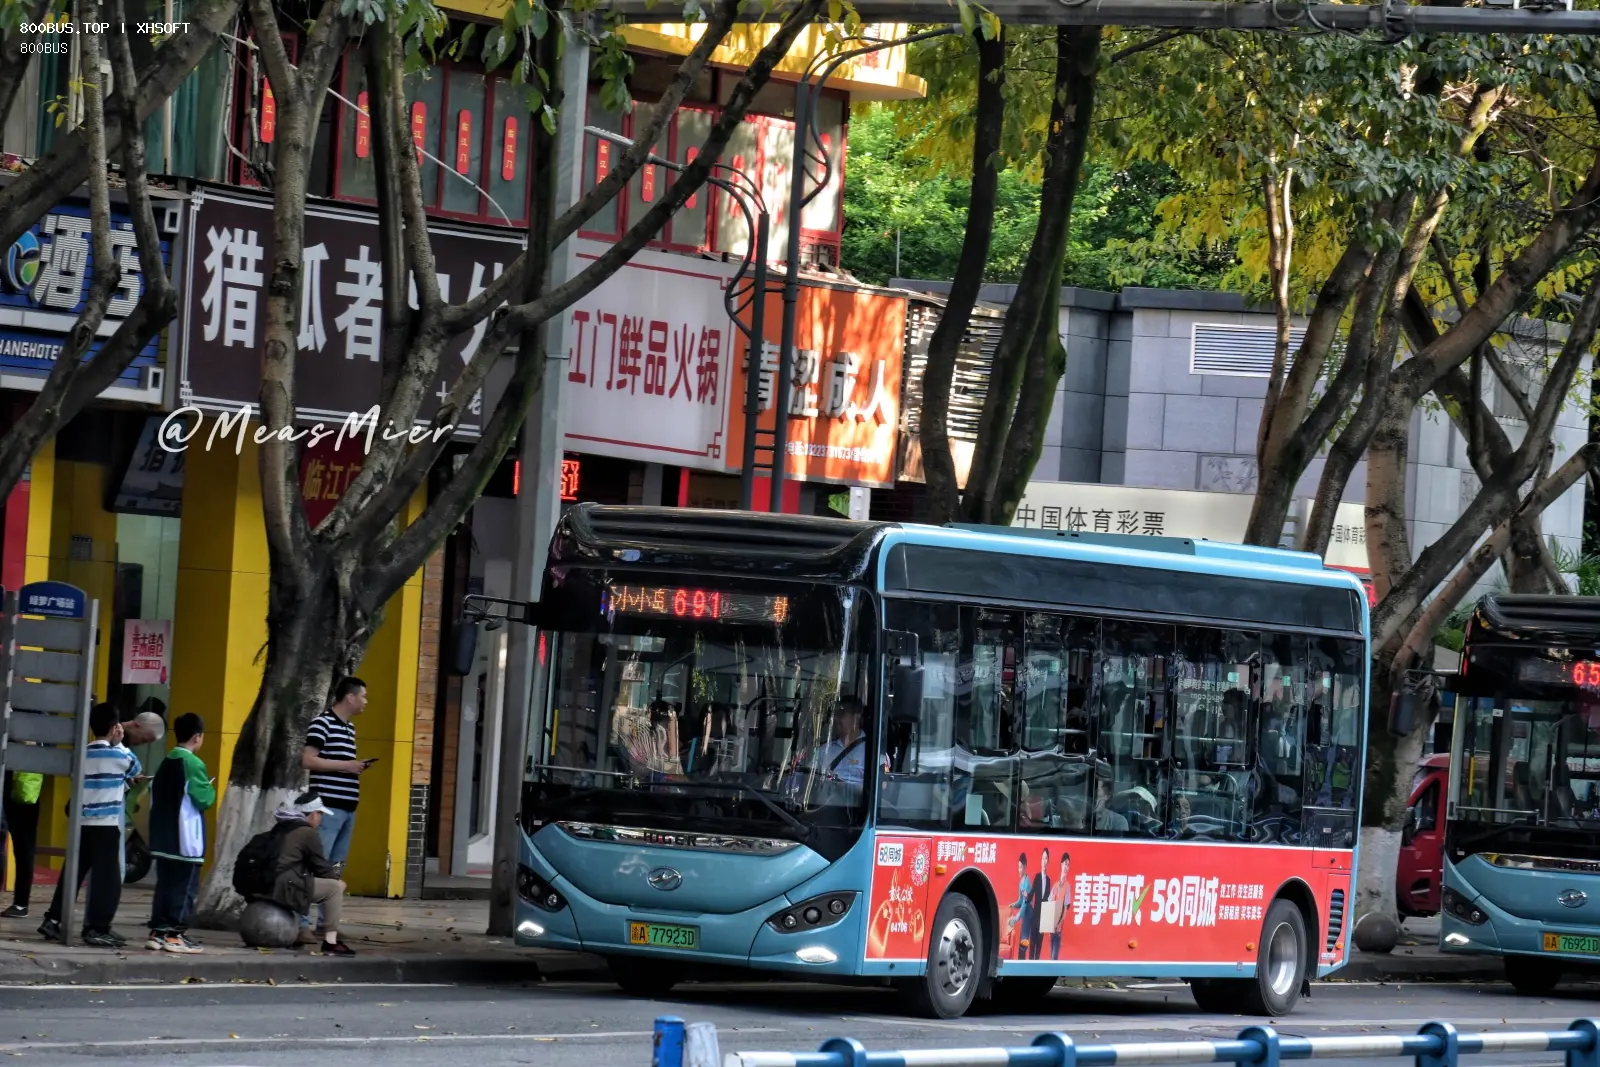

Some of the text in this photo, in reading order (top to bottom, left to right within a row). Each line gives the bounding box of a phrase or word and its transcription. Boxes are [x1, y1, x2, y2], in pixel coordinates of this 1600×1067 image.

[0, 340, 64, 360] ANGHOTE
[1016, 503, 1165, 536] 中国体育彩票
[673, 588, 721, 619] 691
[1073, 872, 1220, 927] 事事可成 58同城
[651, 927, 695, 946] 77923D
